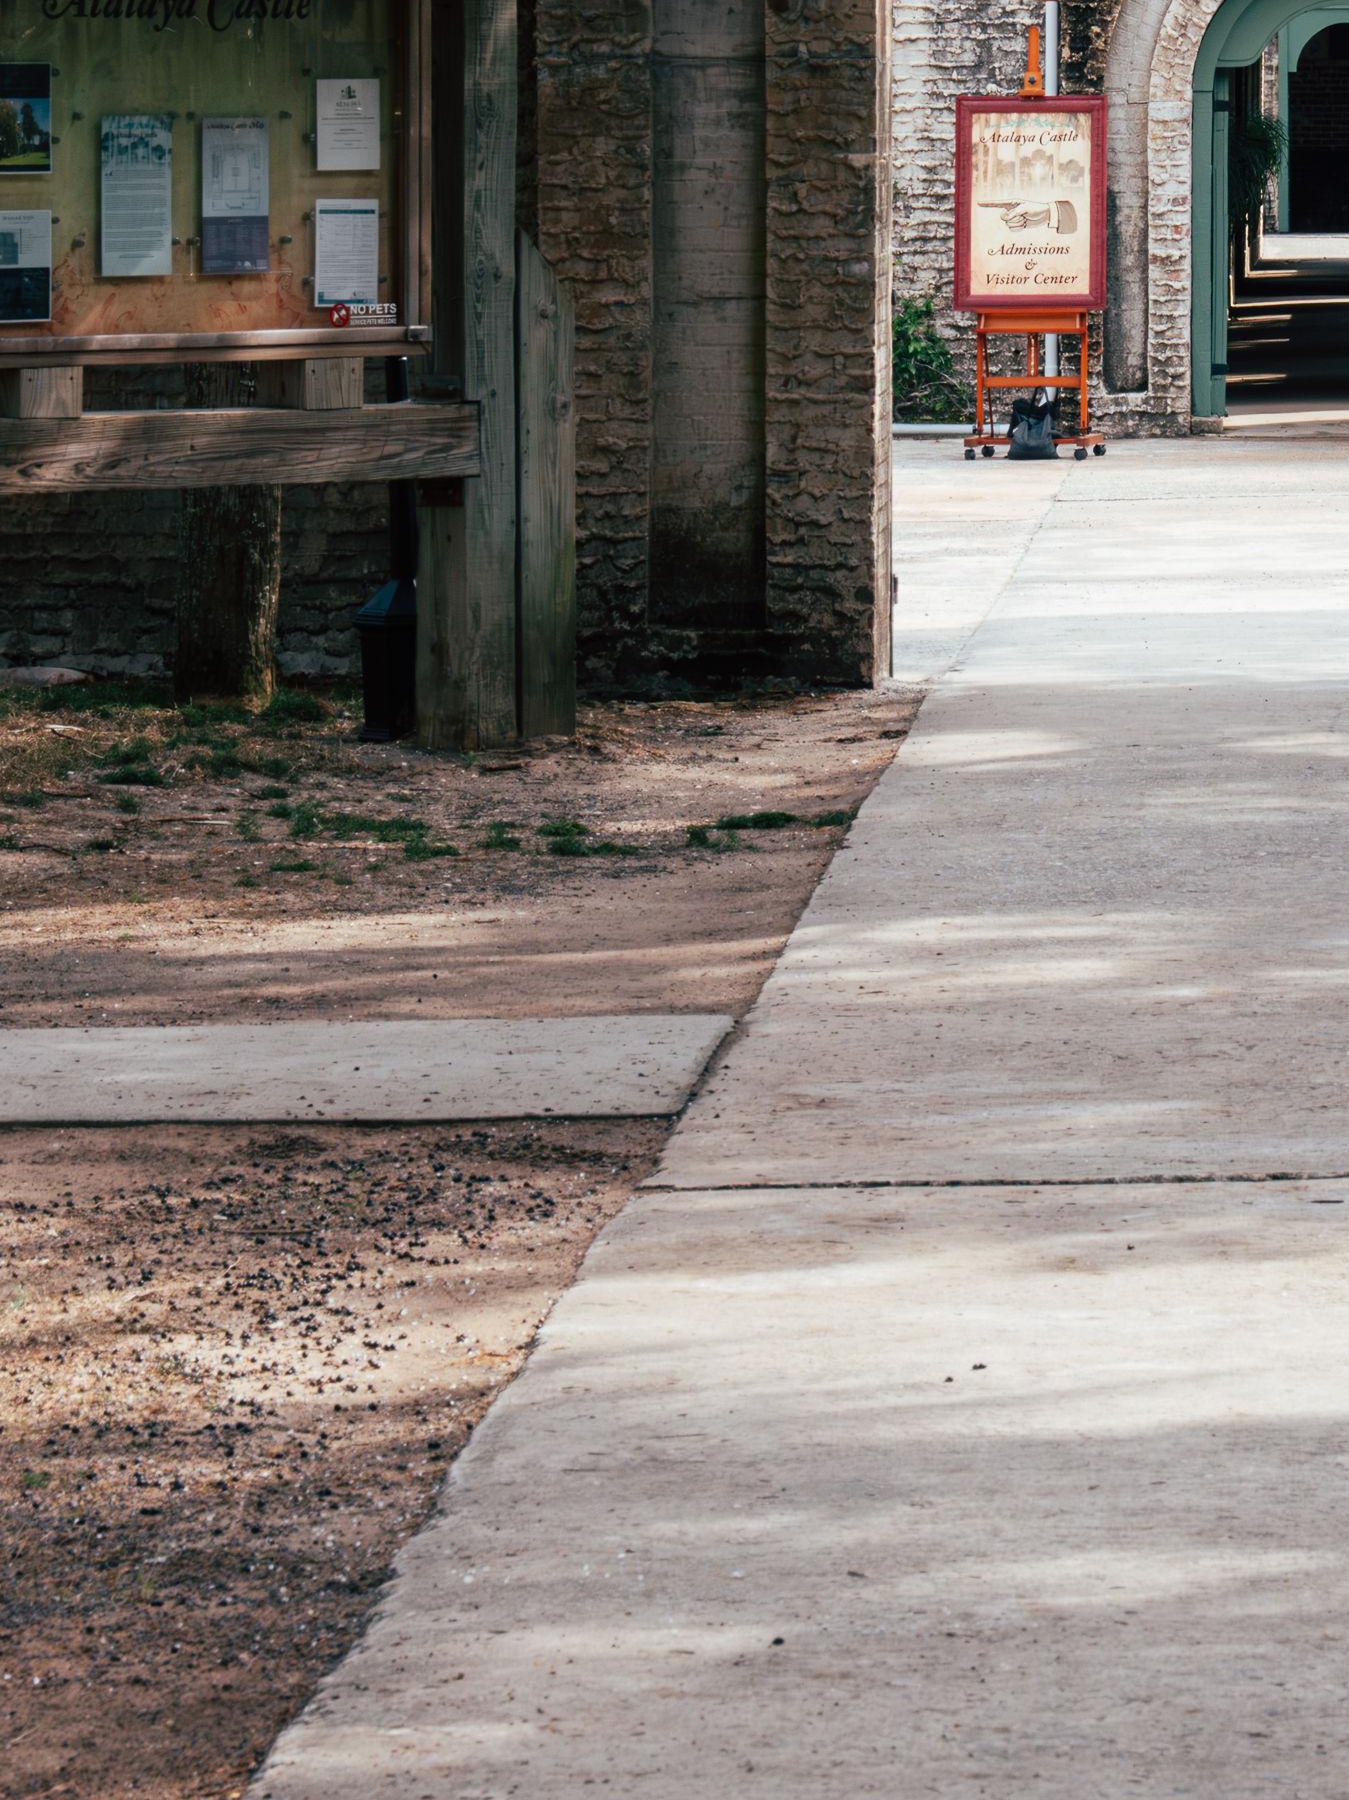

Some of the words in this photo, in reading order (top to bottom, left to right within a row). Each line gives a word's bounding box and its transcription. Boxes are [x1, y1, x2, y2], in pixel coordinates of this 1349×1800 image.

[980, 131, 1035, 146] Atalaya
[1039, 130, 1079, 146] Castle
[987, 243, 1071, 257] Admissions
[1024, 258, 1038, 271] &
[985, 273, 1030, 286] Visitor
[1034, 273, 1078, 285] Center
[350, 304, 366, 315] NO
[369, 303, 397, 314] PETS
